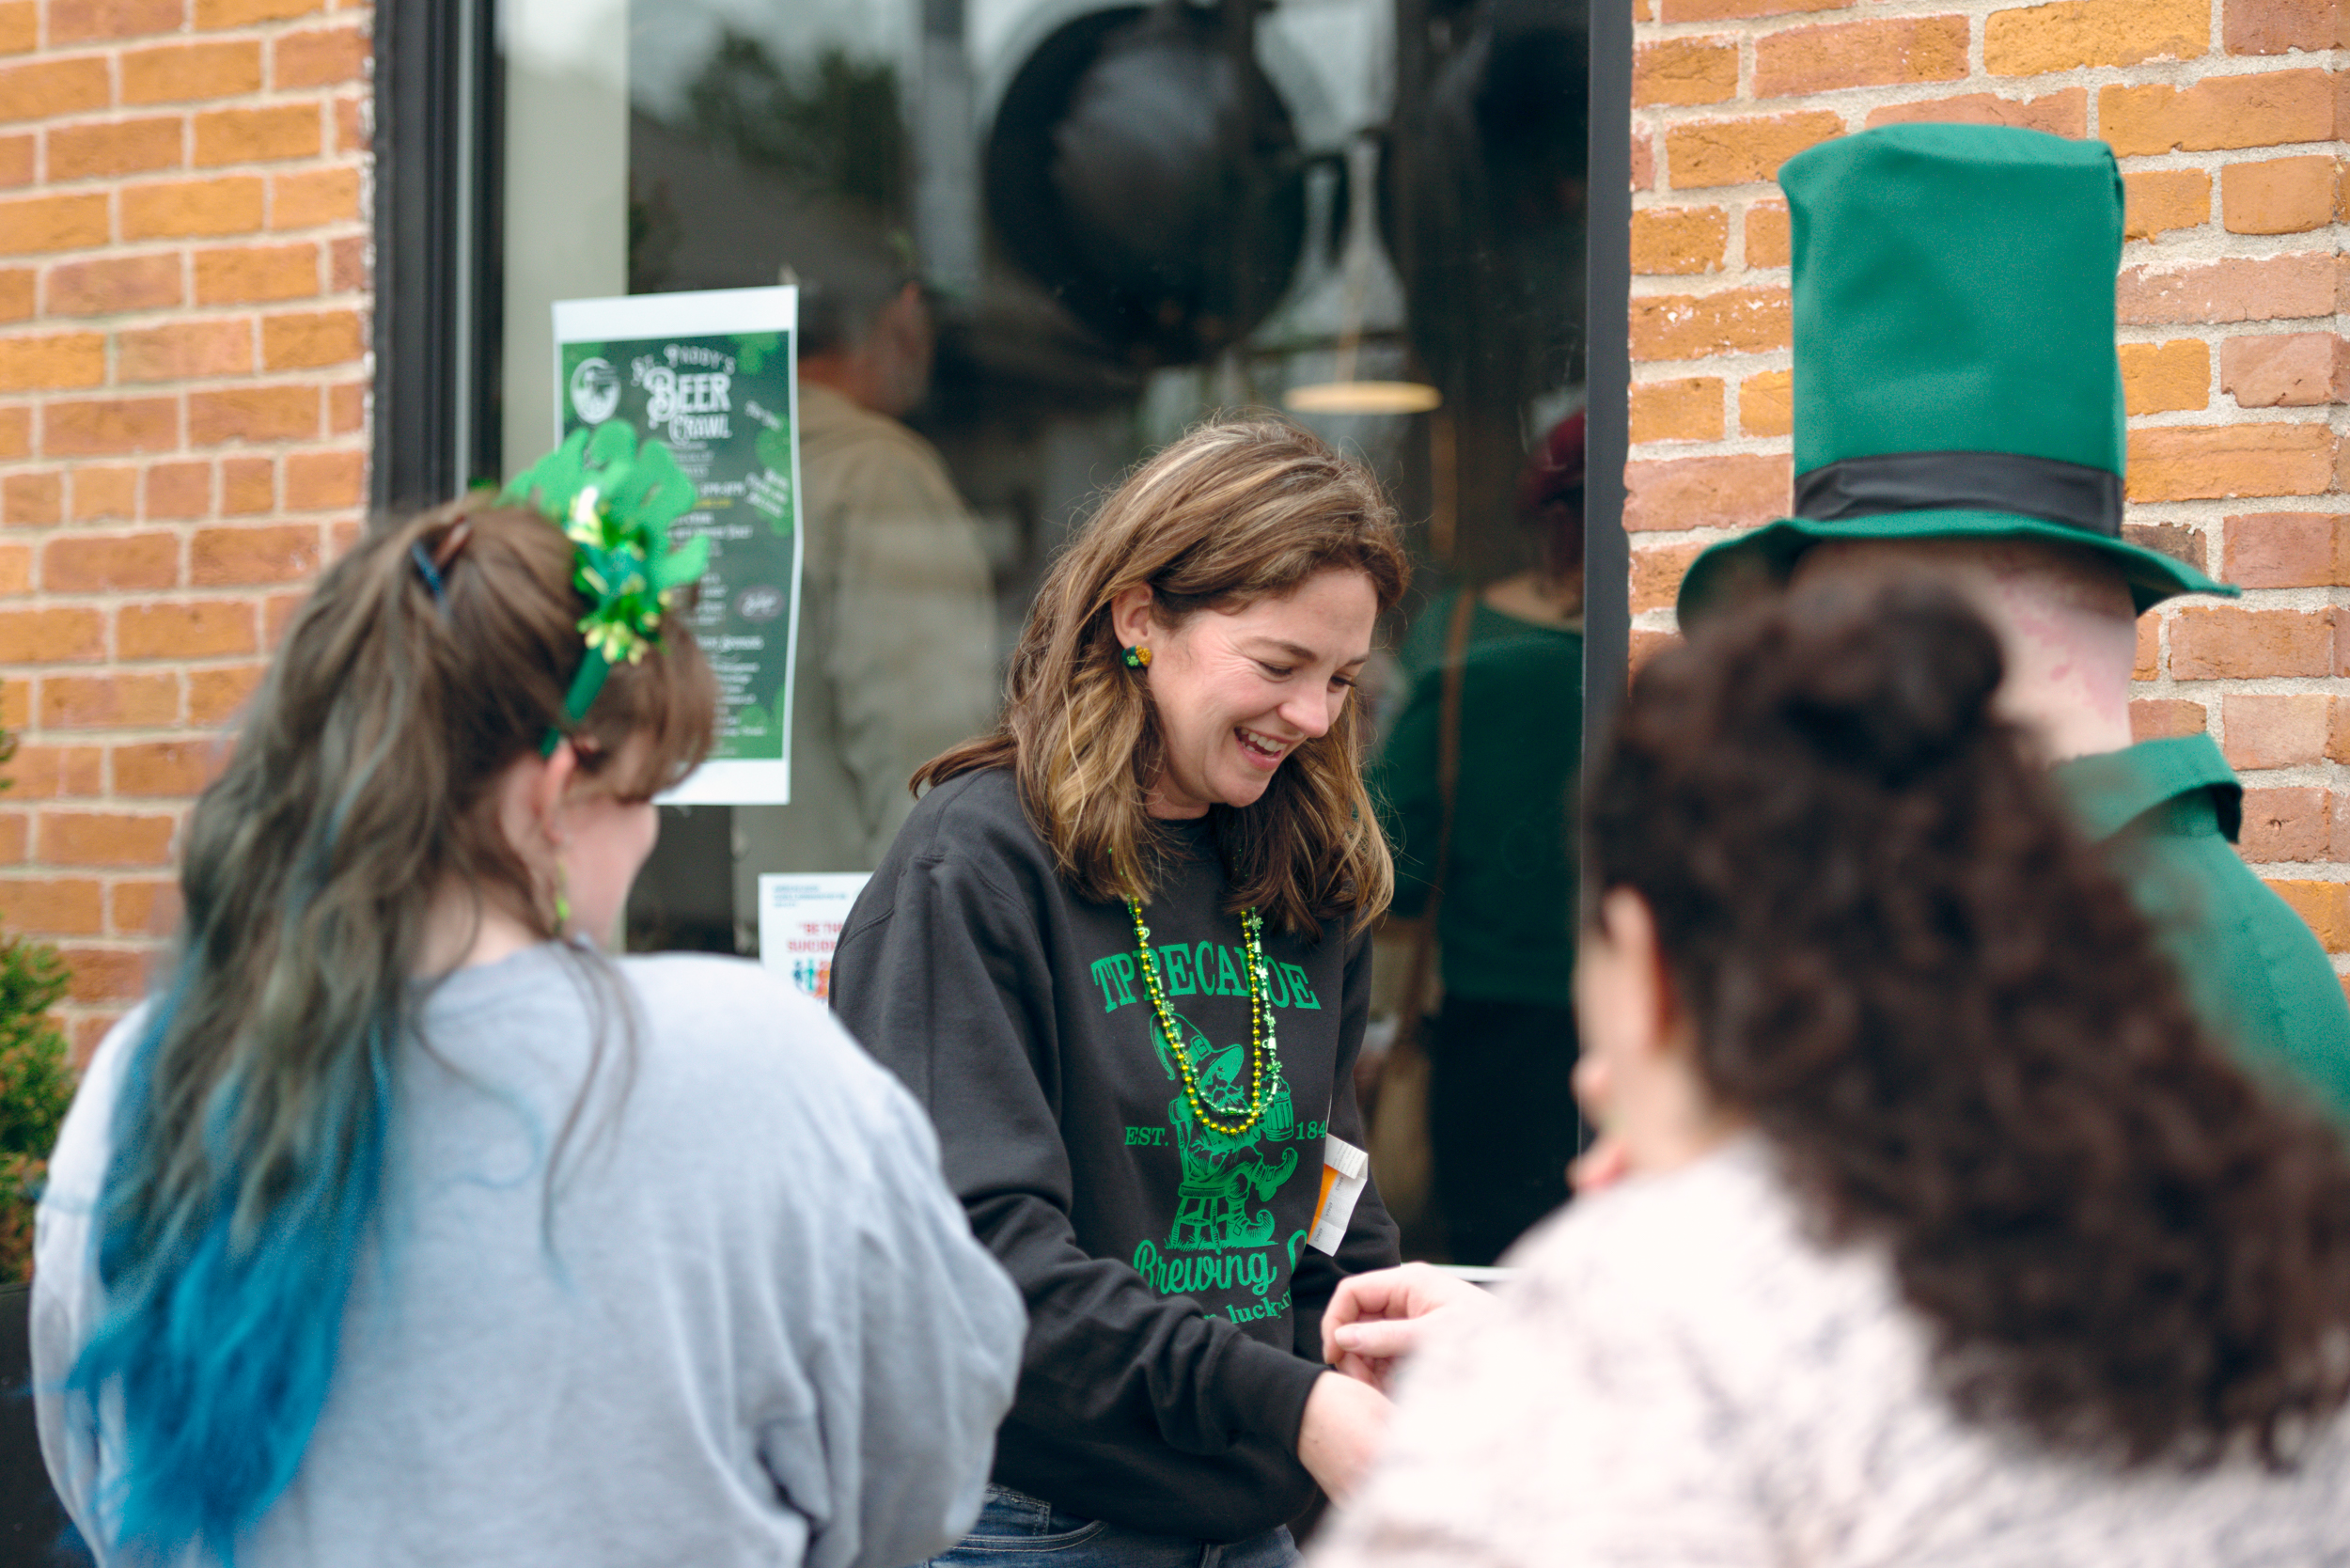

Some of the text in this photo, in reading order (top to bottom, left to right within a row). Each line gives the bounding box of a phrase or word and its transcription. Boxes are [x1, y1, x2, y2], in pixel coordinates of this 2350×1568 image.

[642, 366, 731, 429] BEER
[668, 414, 732, 446] CRAWL
[1090, 940, 1321, 1013] TIPPECANOE
[1125, 1126, 1168, 1146] EST.
[1134, 1239, 1277, 1295] Brewing
